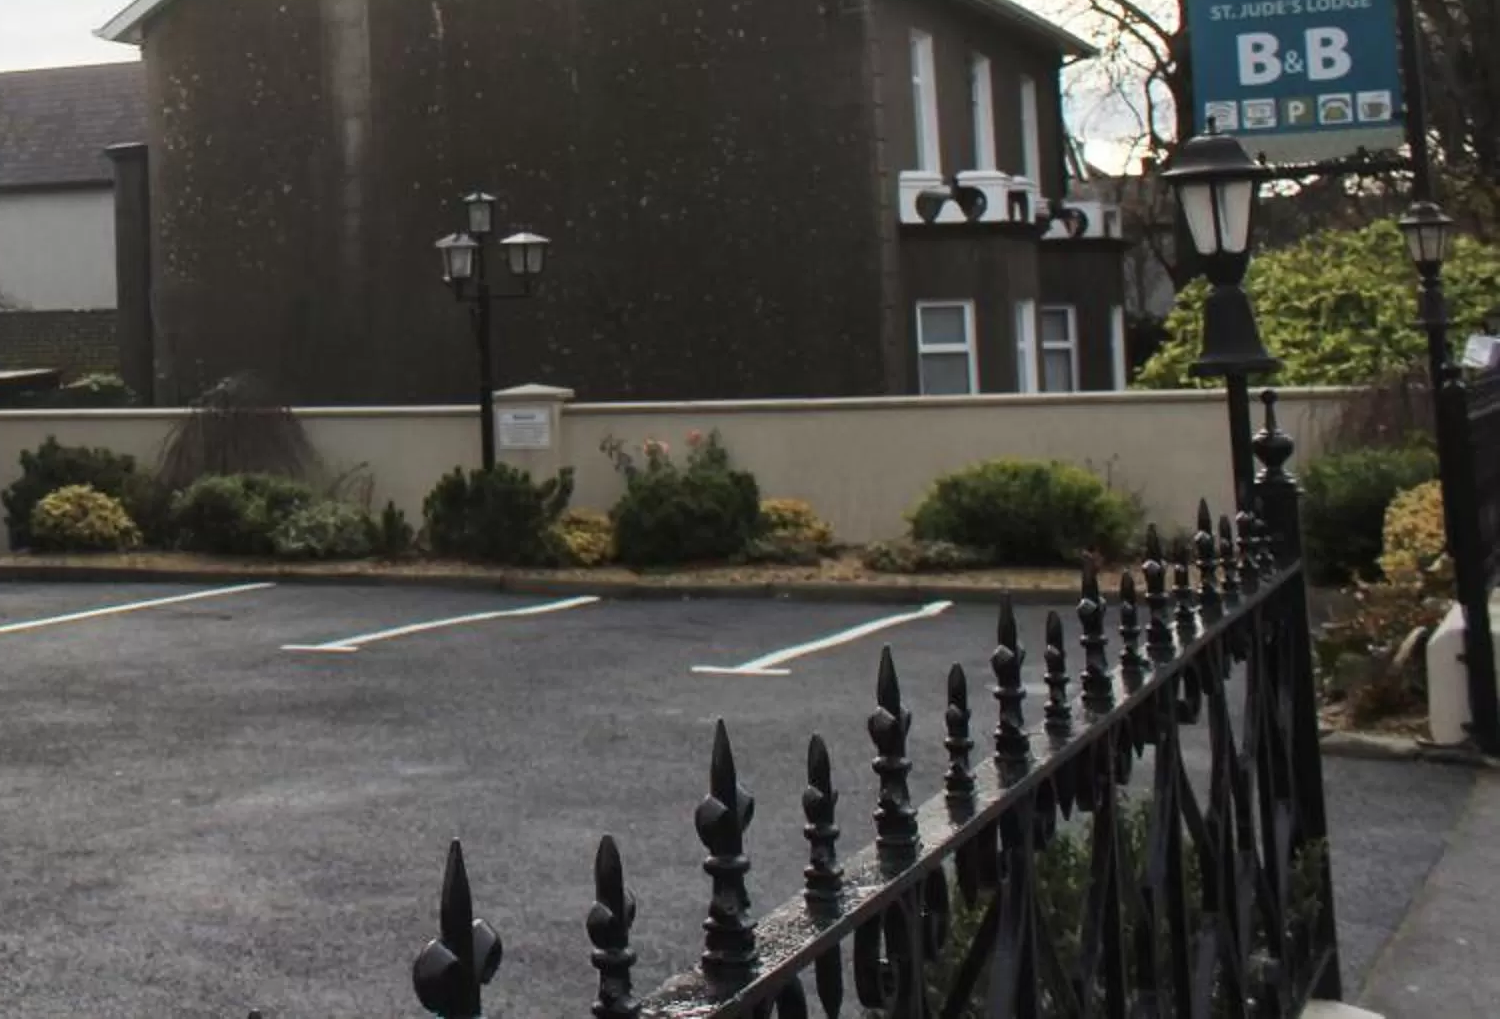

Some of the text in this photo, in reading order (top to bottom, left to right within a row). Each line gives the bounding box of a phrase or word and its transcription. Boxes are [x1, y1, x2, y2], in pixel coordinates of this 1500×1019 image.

[1209, 4, 1236, 22] ST.
[1237, 26, 1352, 86] B&B
[1288, 100, 1305, 124] P
